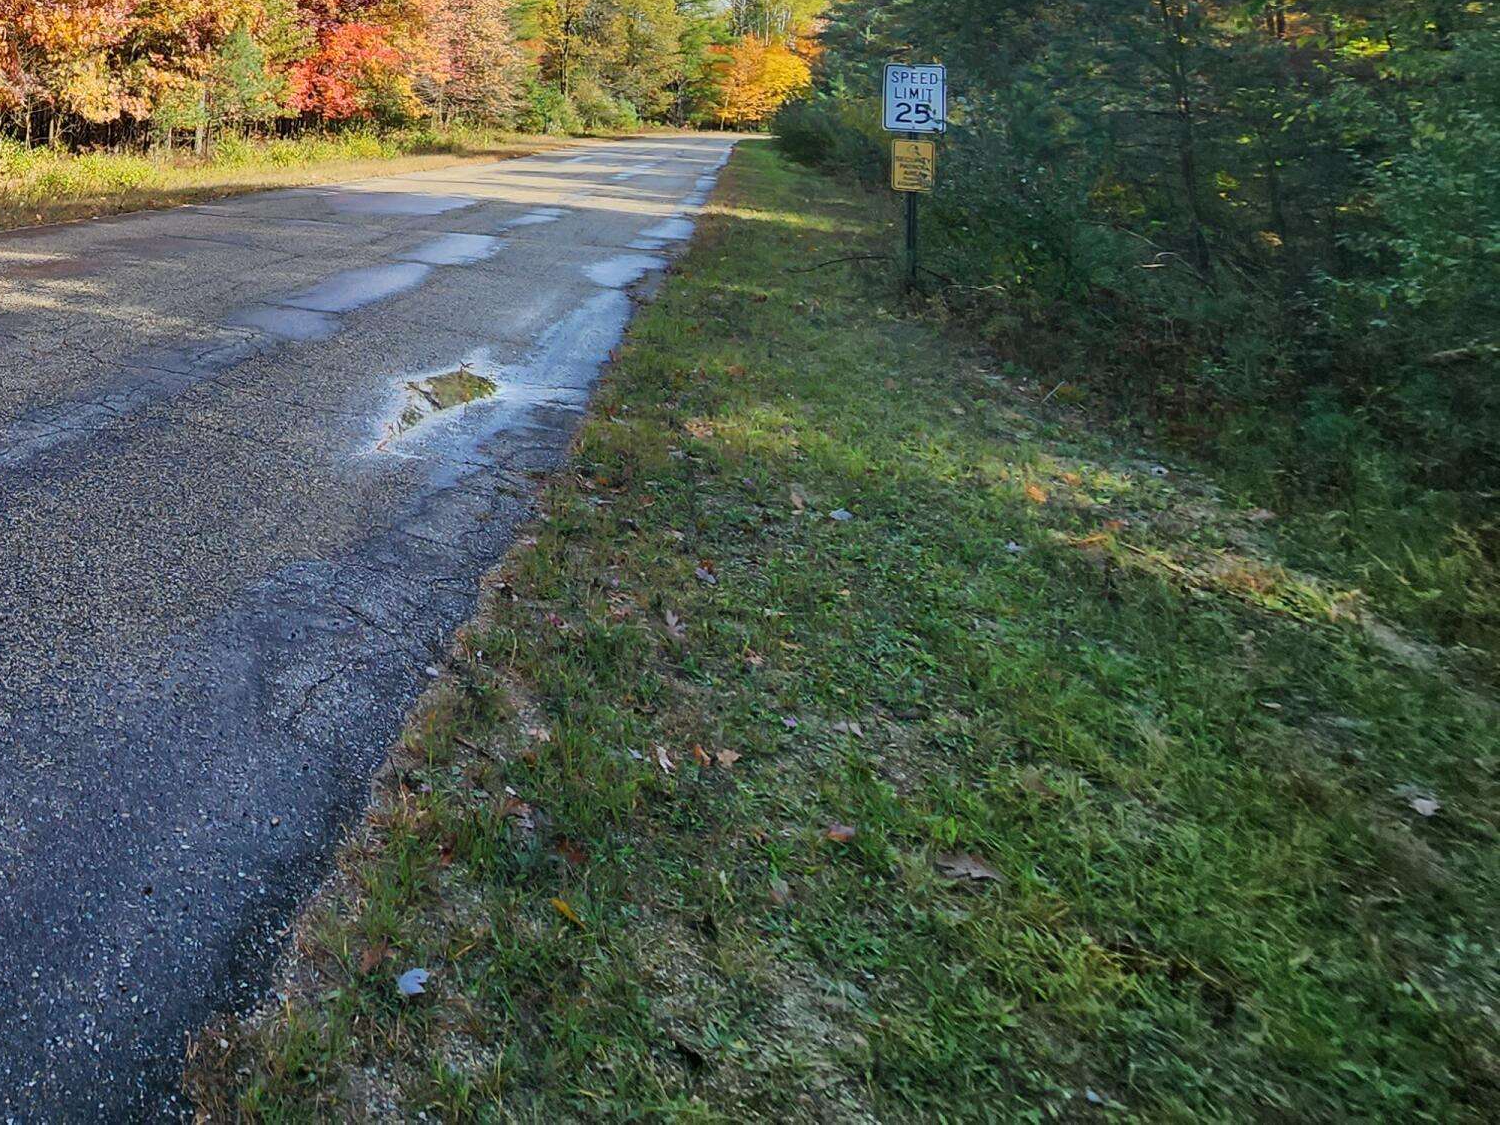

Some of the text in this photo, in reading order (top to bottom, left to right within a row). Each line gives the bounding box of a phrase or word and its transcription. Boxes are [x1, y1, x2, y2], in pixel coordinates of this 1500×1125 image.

[891, 71, 938, 84] SPEED
[895, 87, 933, 100] LIMIT
[895, 102, 932, 124] 25
